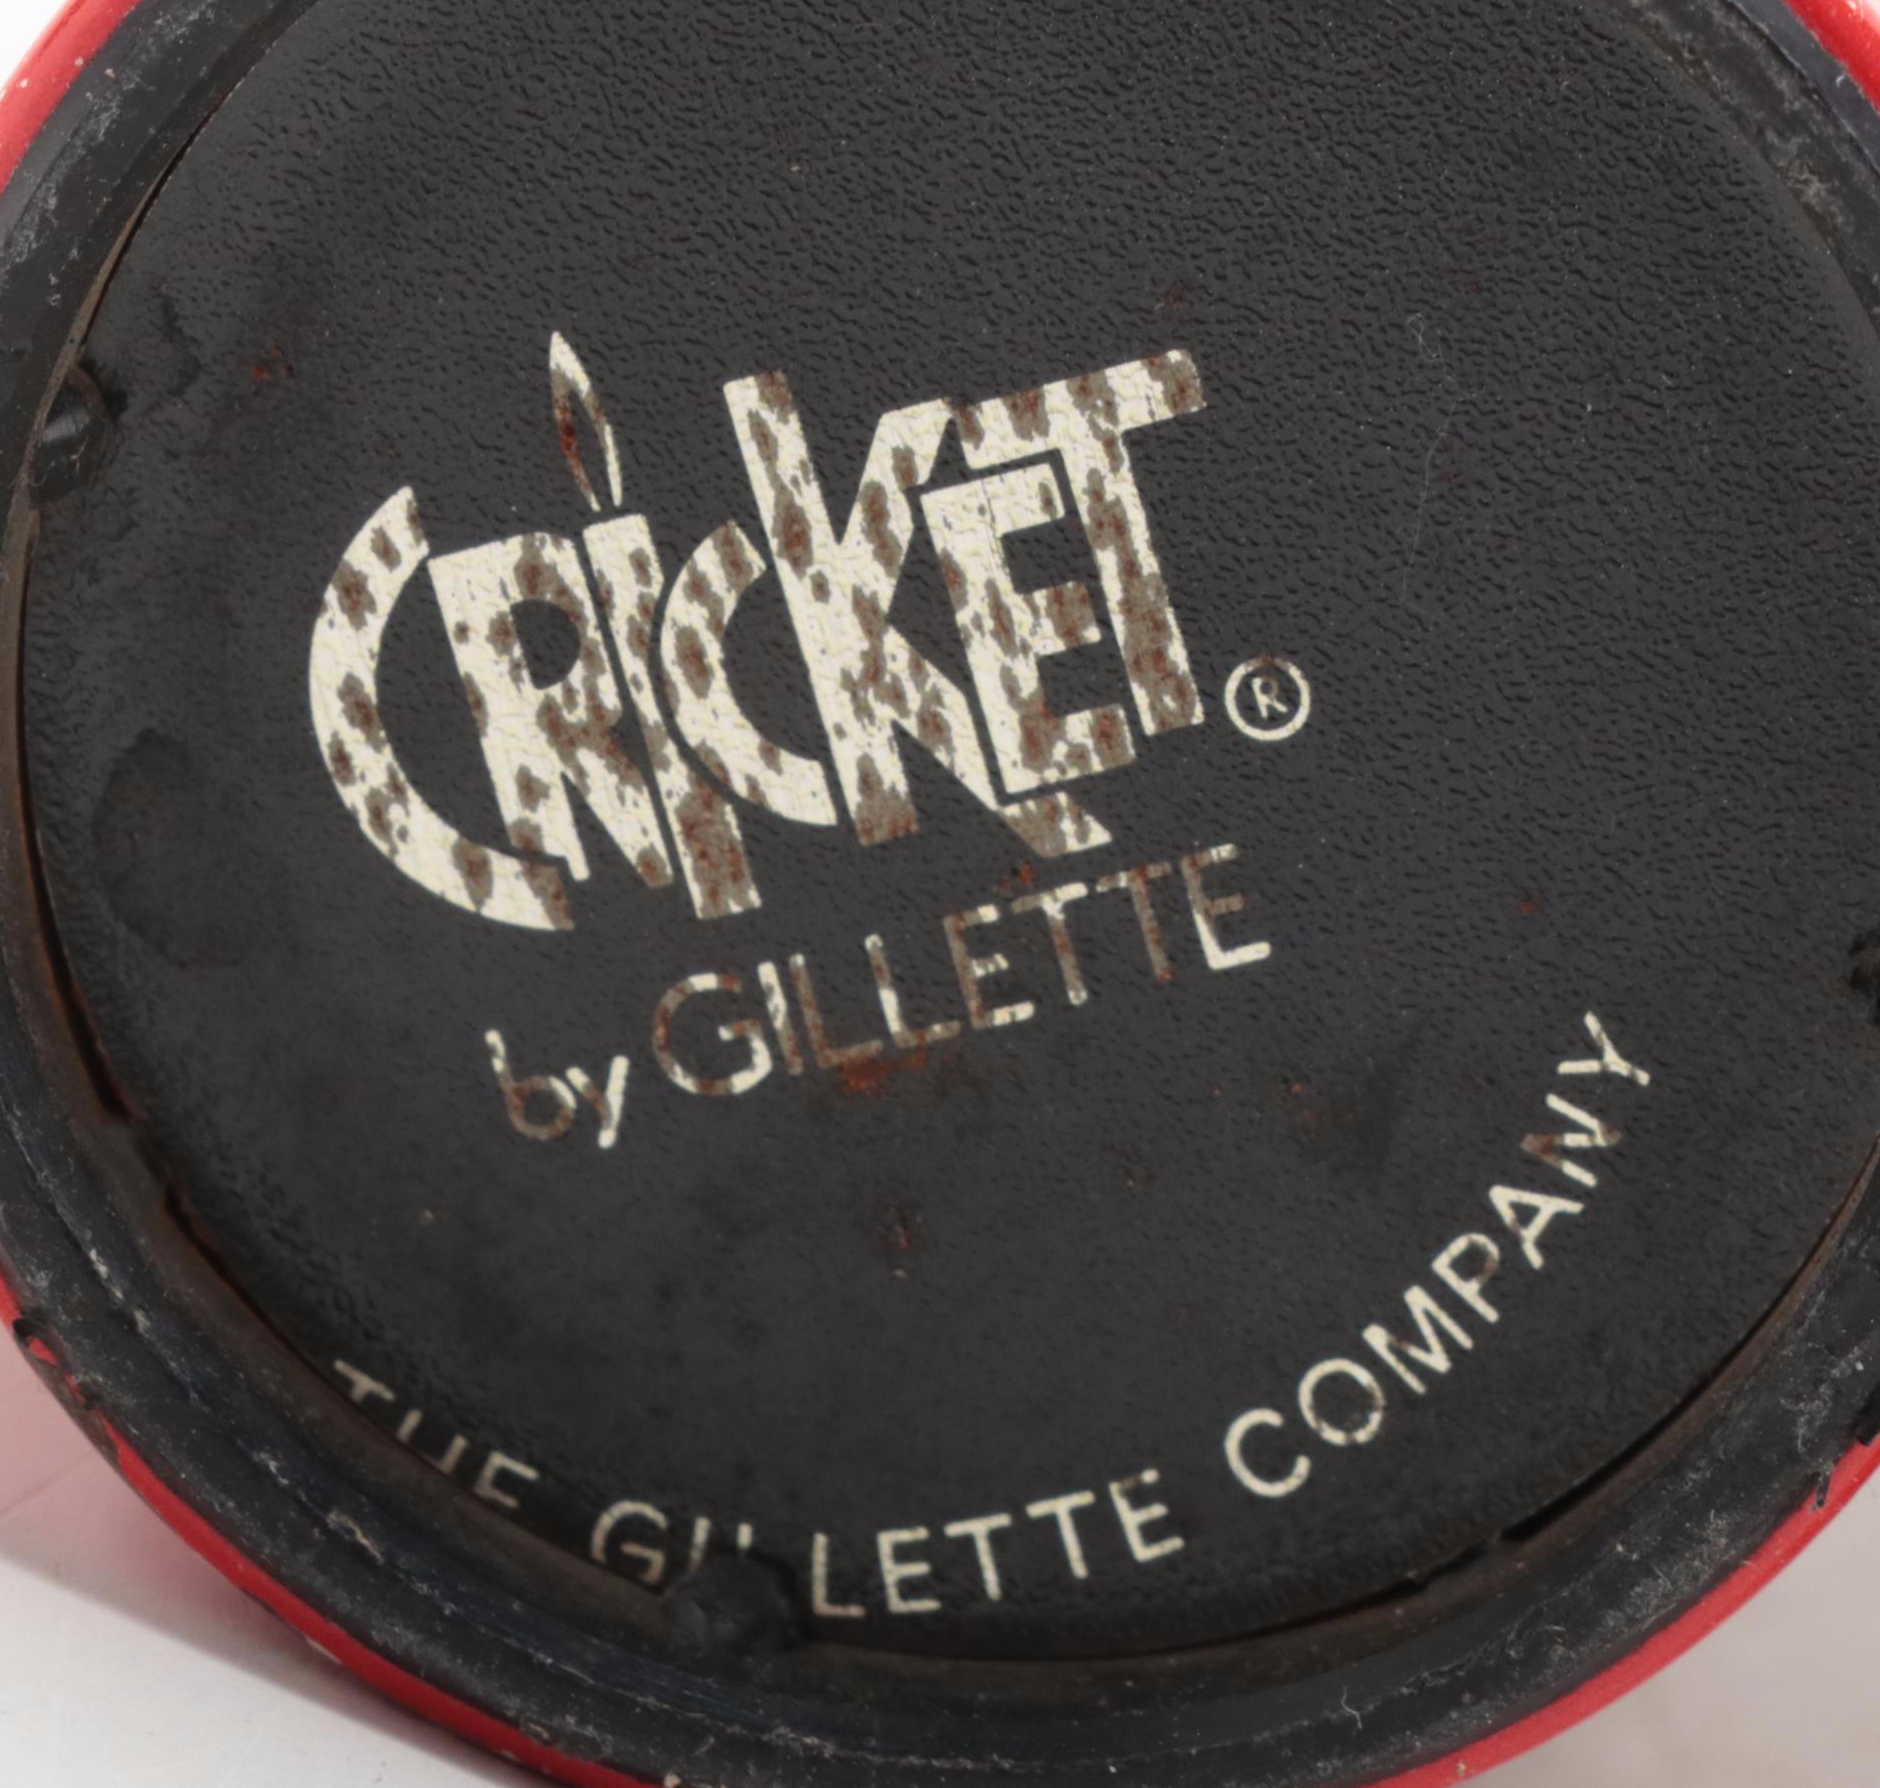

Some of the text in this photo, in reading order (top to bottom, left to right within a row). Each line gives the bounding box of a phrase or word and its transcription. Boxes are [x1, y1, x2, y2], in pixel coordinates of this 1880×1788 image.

[308, 331, 1205, 931] CRICKET
[484, 842, 1272, 1149] by GILLETTE
[1224, 1010, 1651, 1498] COMPANY
